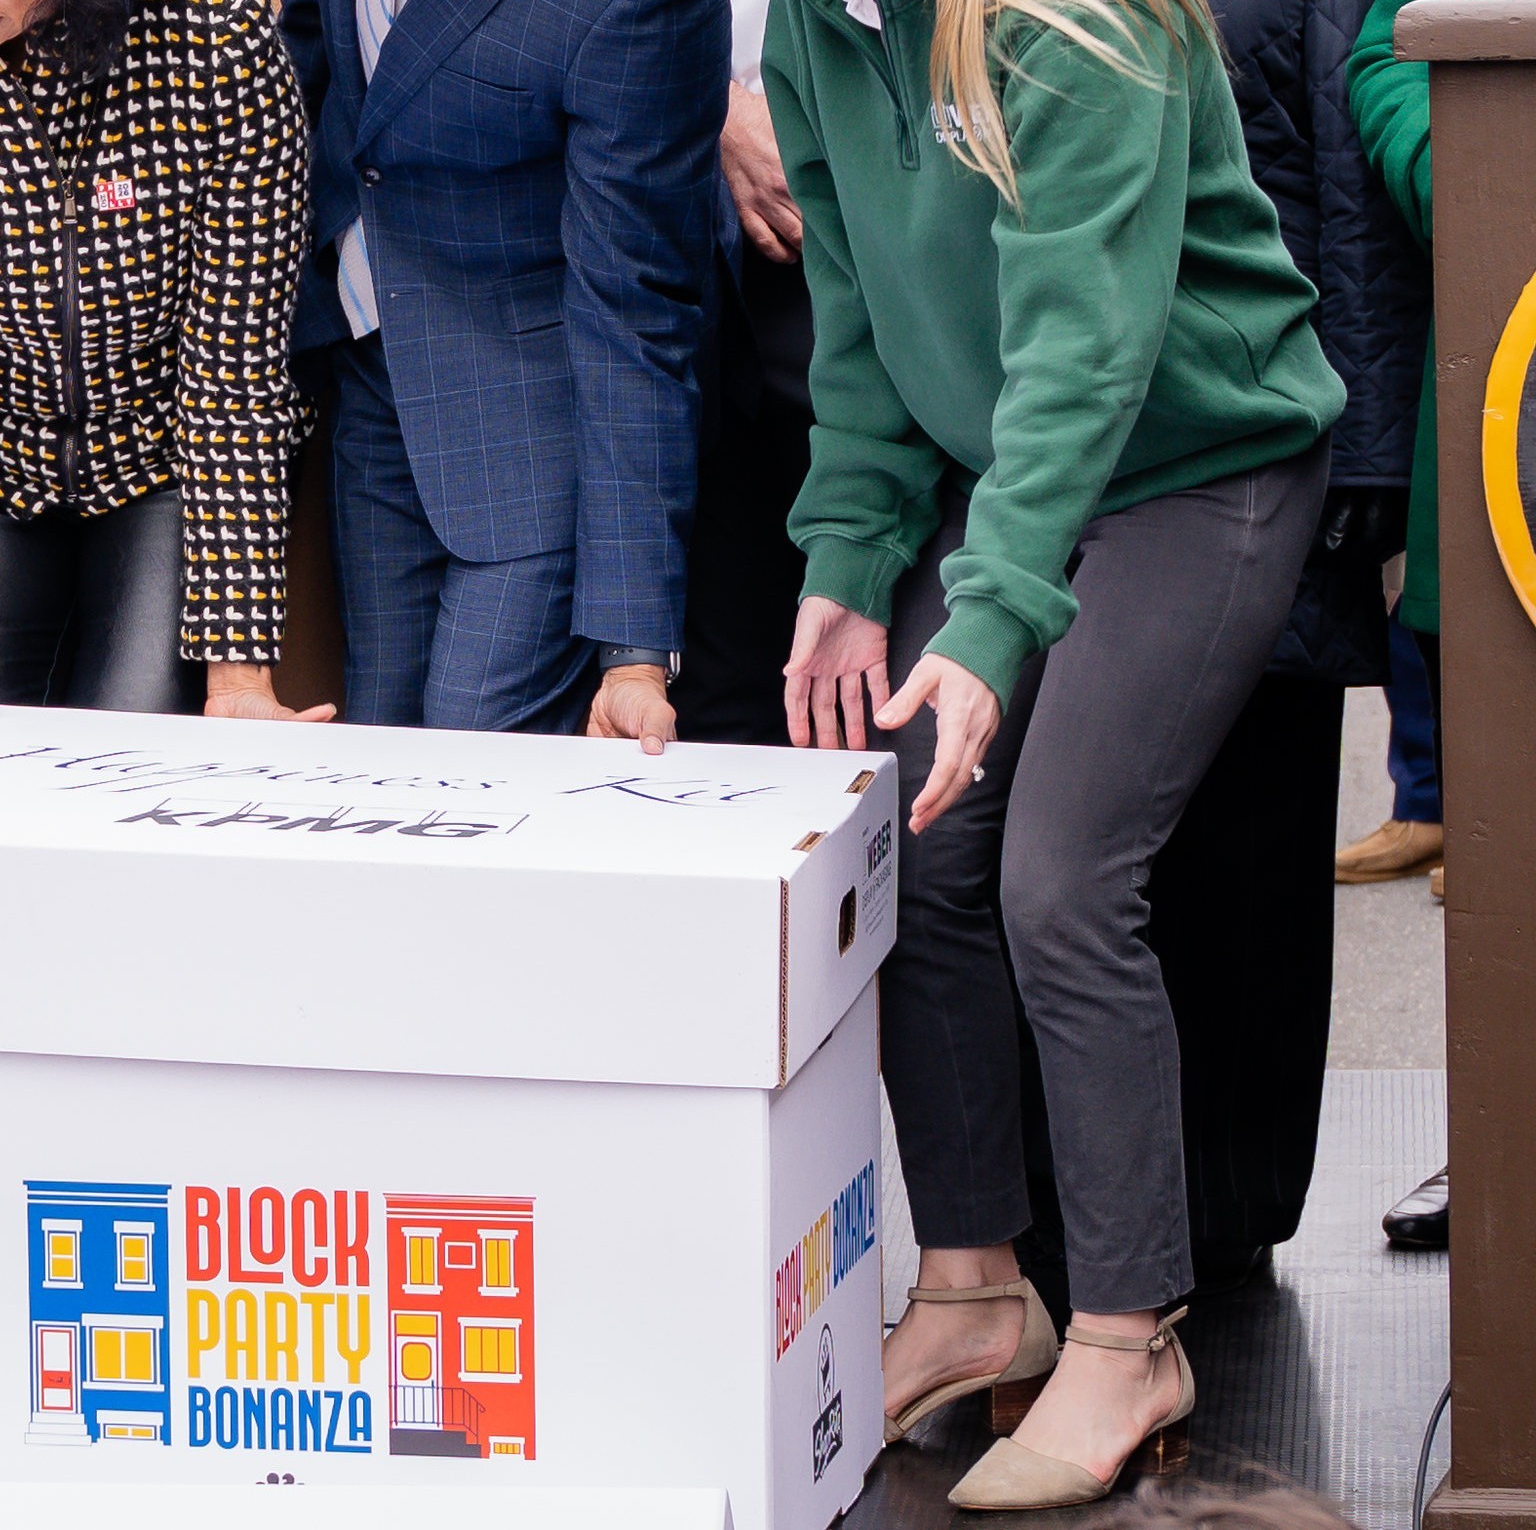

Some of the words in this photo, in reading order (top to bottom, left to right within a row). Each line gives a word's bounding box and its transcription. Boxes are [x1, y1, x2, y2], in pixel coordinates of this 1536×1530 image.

[114, 808, 500, 838] KPMG
[556, 775, 783, 808] Kit
[185, 1185, 370, 1287] BLOCK
[776, 1241, 802, 1363] BLOCK
[802, 1206, 831, 1325] PARTY
[833, 1158, 875, 1289] BONANZA
[187, 1288, 371, 1384] PARTY
[188, 1385, 372, 1454] BONANZA
